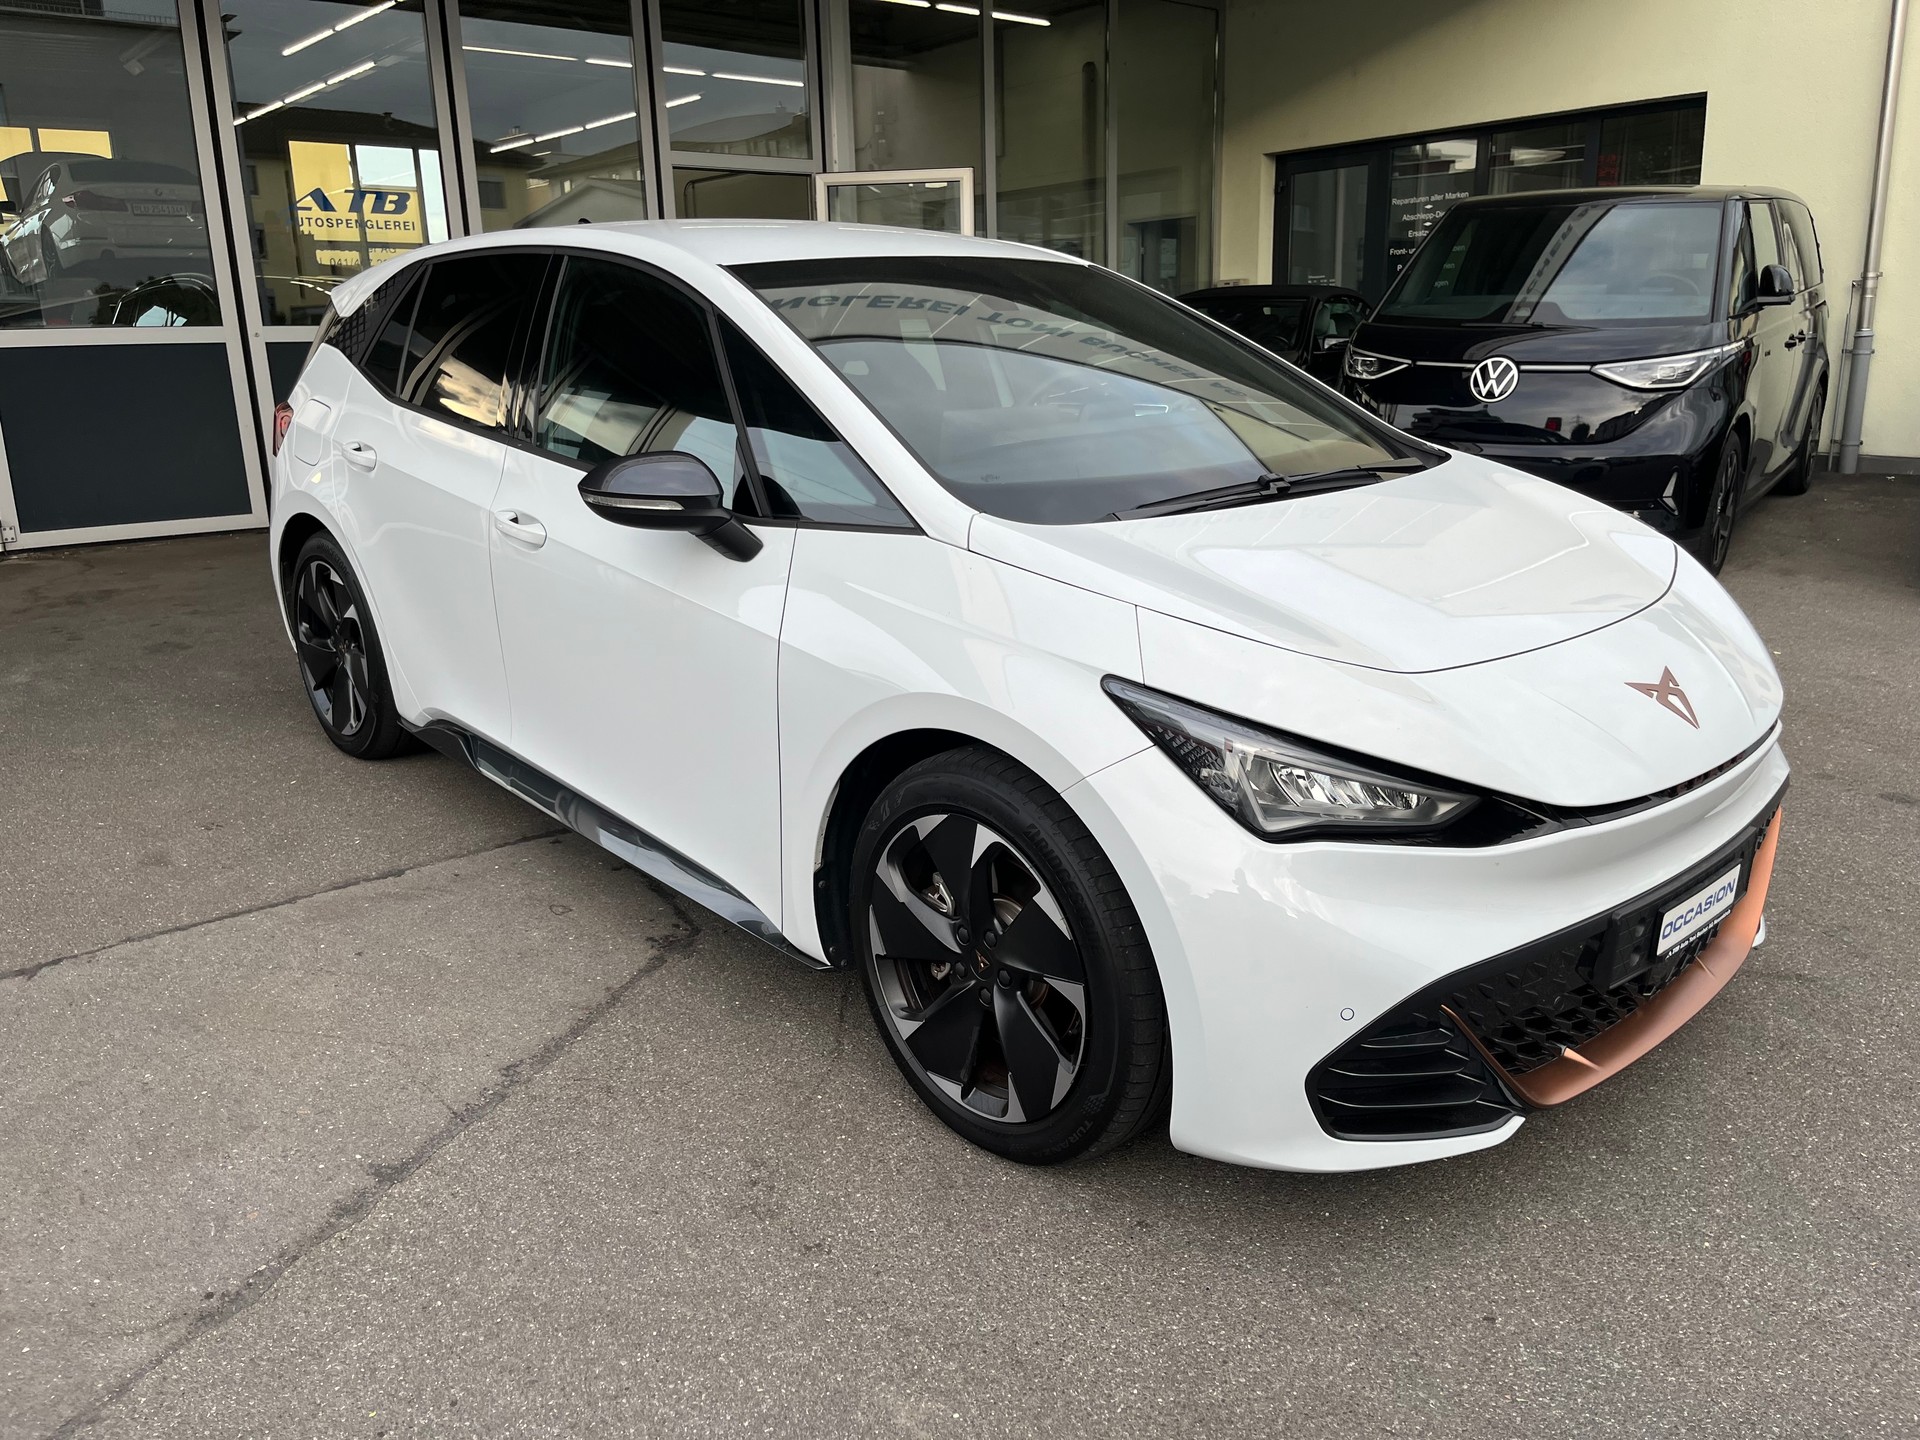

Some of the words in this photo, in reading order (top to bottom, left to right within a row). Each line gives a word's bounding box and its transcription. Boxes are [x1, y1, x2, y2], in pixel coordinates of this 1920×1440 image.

[1391, 196, 1429, 206] Reparaturen
[1430, 193, 1444, 202] aller
[1445, 191, 1469, 200] Marken
[298, 217, 416, 231] UTOSPENGLEREI
[1661, 877, 1736, 940] OCCASION
